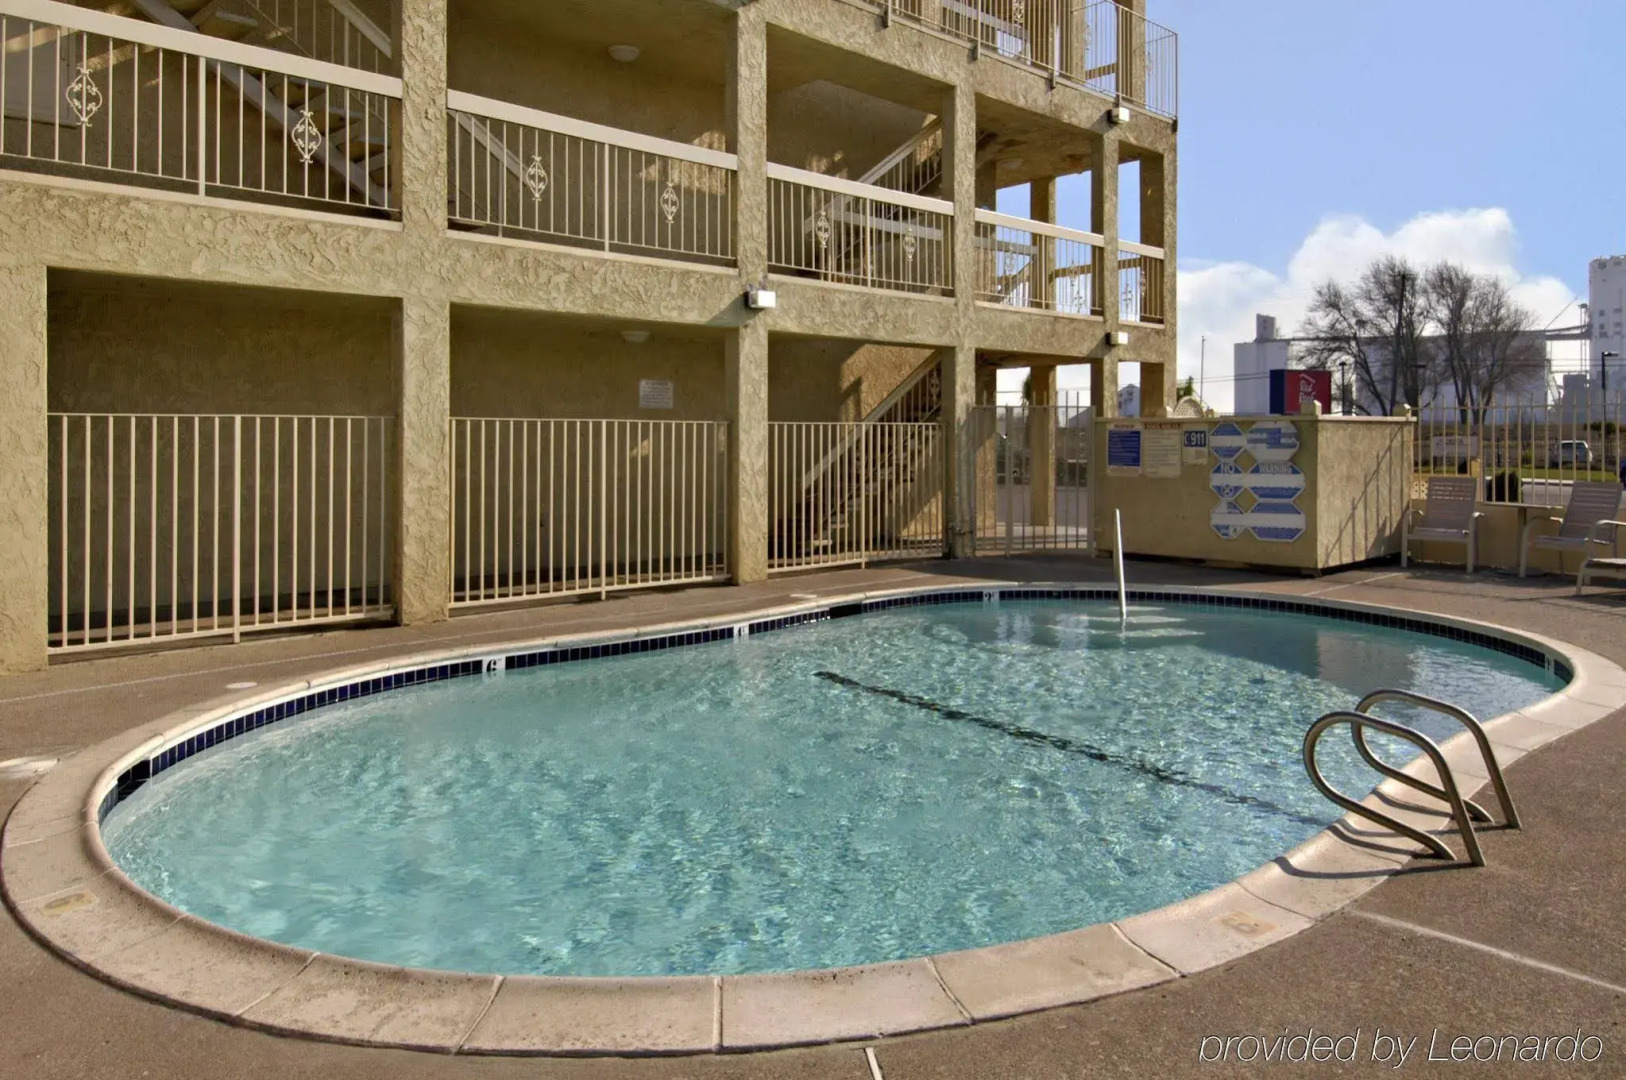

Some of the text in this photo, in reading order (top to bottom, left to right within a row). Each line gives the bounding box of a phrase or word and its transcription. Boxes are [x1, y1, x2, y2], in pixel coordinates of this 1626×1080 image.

[1300, 380, 1313, 392] Red
[1190, 432, 1205, 446] 911
[1220, 463, 1235, 474] NO
[1259, 463, 1292, 474] WARNING
